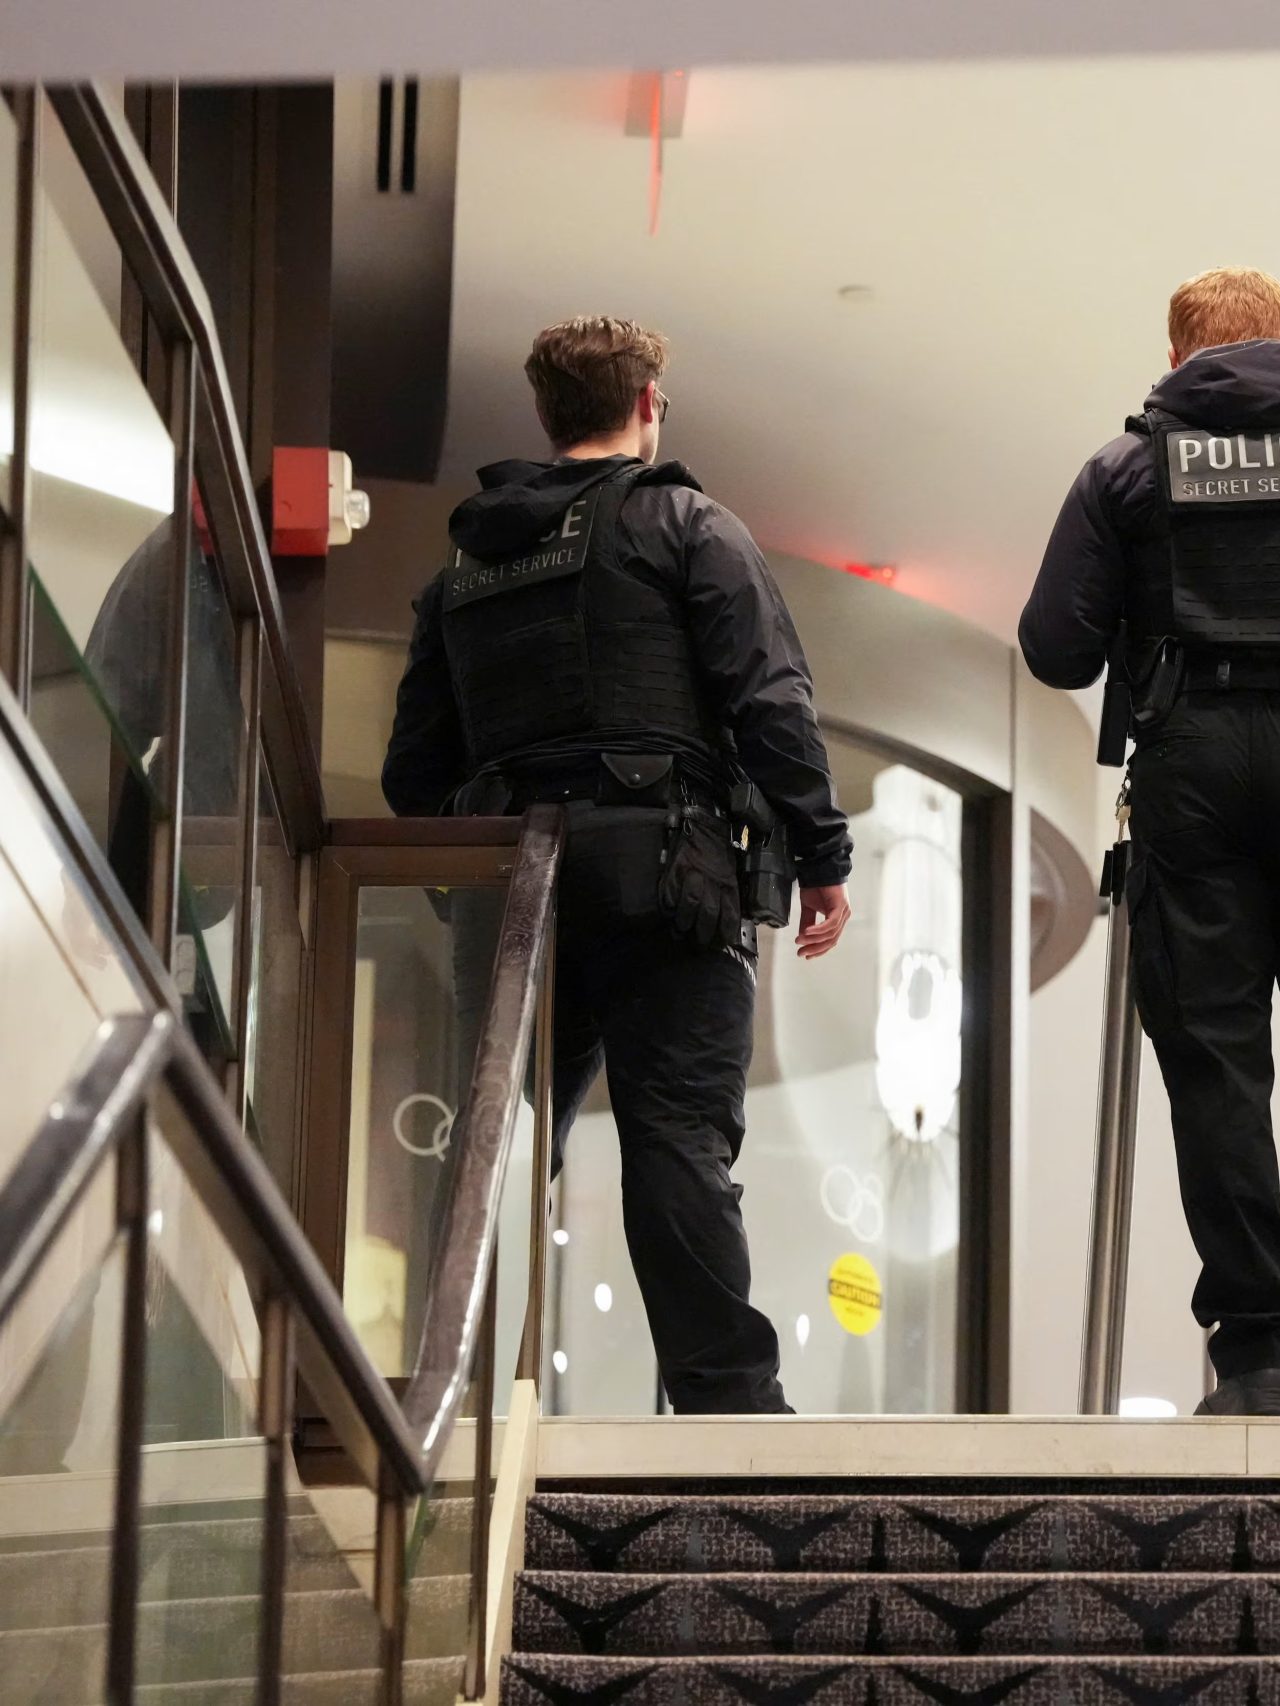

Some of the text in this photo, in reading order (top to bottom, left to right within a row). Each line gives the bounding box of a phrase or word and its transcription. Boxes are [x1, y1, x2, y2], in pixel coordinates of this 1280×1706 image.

[1182, 478, 1250, 496] SECRET
[452, 547, 577, 596] SECRET SERVICE
